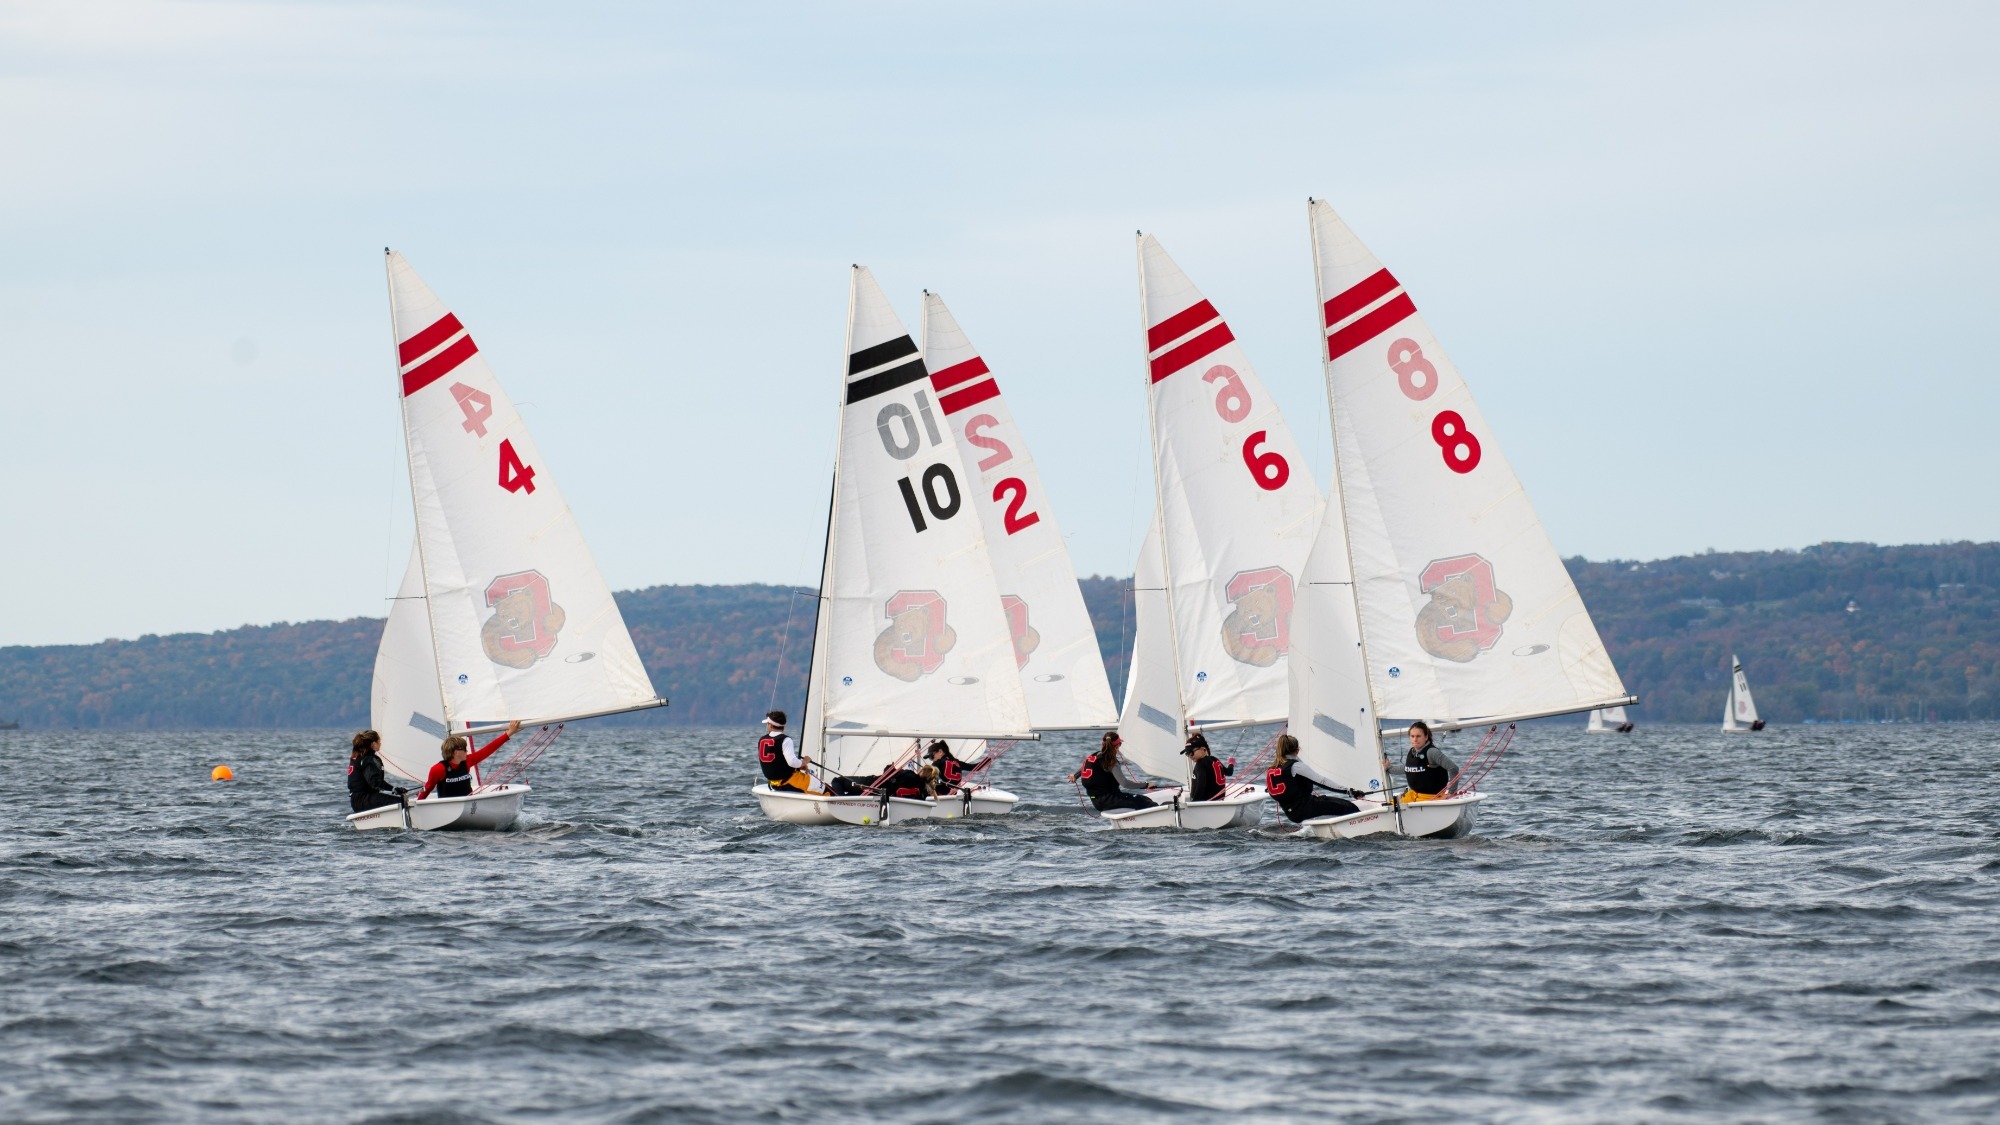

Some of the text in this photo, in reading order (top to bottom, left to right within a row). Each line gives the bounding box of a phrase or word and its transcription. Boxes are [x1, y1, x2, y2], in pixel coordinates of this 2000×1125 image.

[498, 437, 536, 495] 4
[1242, 430, 1290, 491] 6
[1431, 409, 1482, 474] 8
[897, 462, 962, 534] 10
[992, 477, 1041, 536] 2
[758, 738, 776, 763] C
[944, 759, 962, 781] C
[1081, 754, 1097, 779] C
[1266, 767, 1287, 796] C
